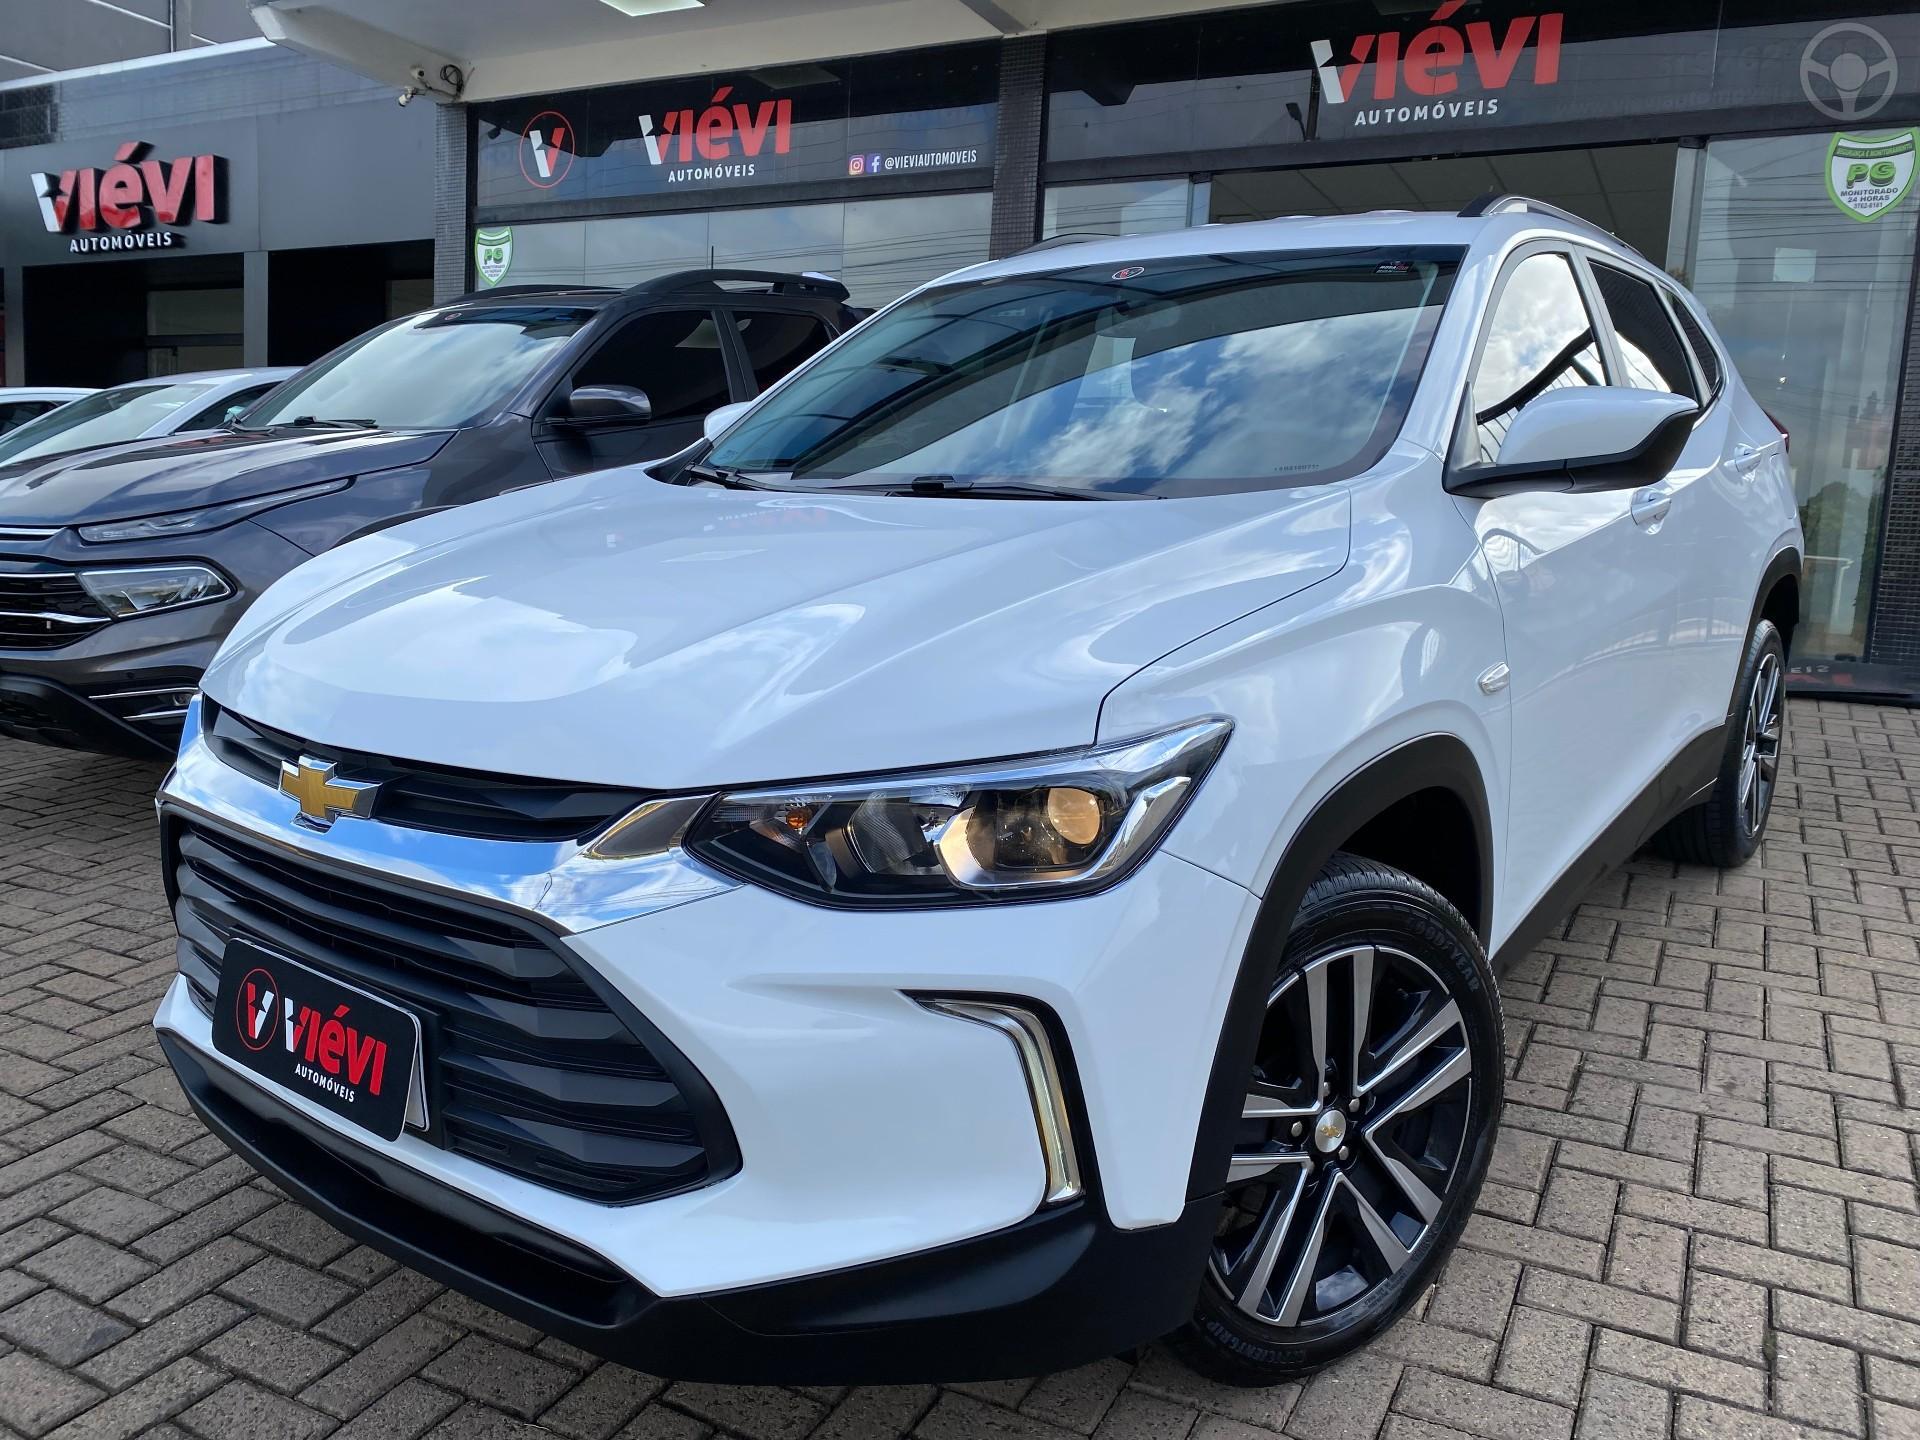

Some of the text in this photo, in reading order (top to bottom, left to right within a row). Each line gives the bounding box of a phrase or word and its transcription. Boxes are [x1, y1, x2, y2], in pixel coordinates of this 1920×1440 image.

[1354, 98, 1500, 126] AUTOMÓVEIS
[884, 149, 978, 170] @VIEVIAUTOMOVEIS
[667, 163, 757, 183] AUTOMÓVEIS
[1846, 161, 1897, 189] PG
[1840, 188, 1899, 196] MONITORADO
[1859, 194, 1891, 203] HORAS
[69, 231, 173, 253] AUTOMÓVEIS
[295, 1063, 356, 1103] AUTOMÓVEIS
